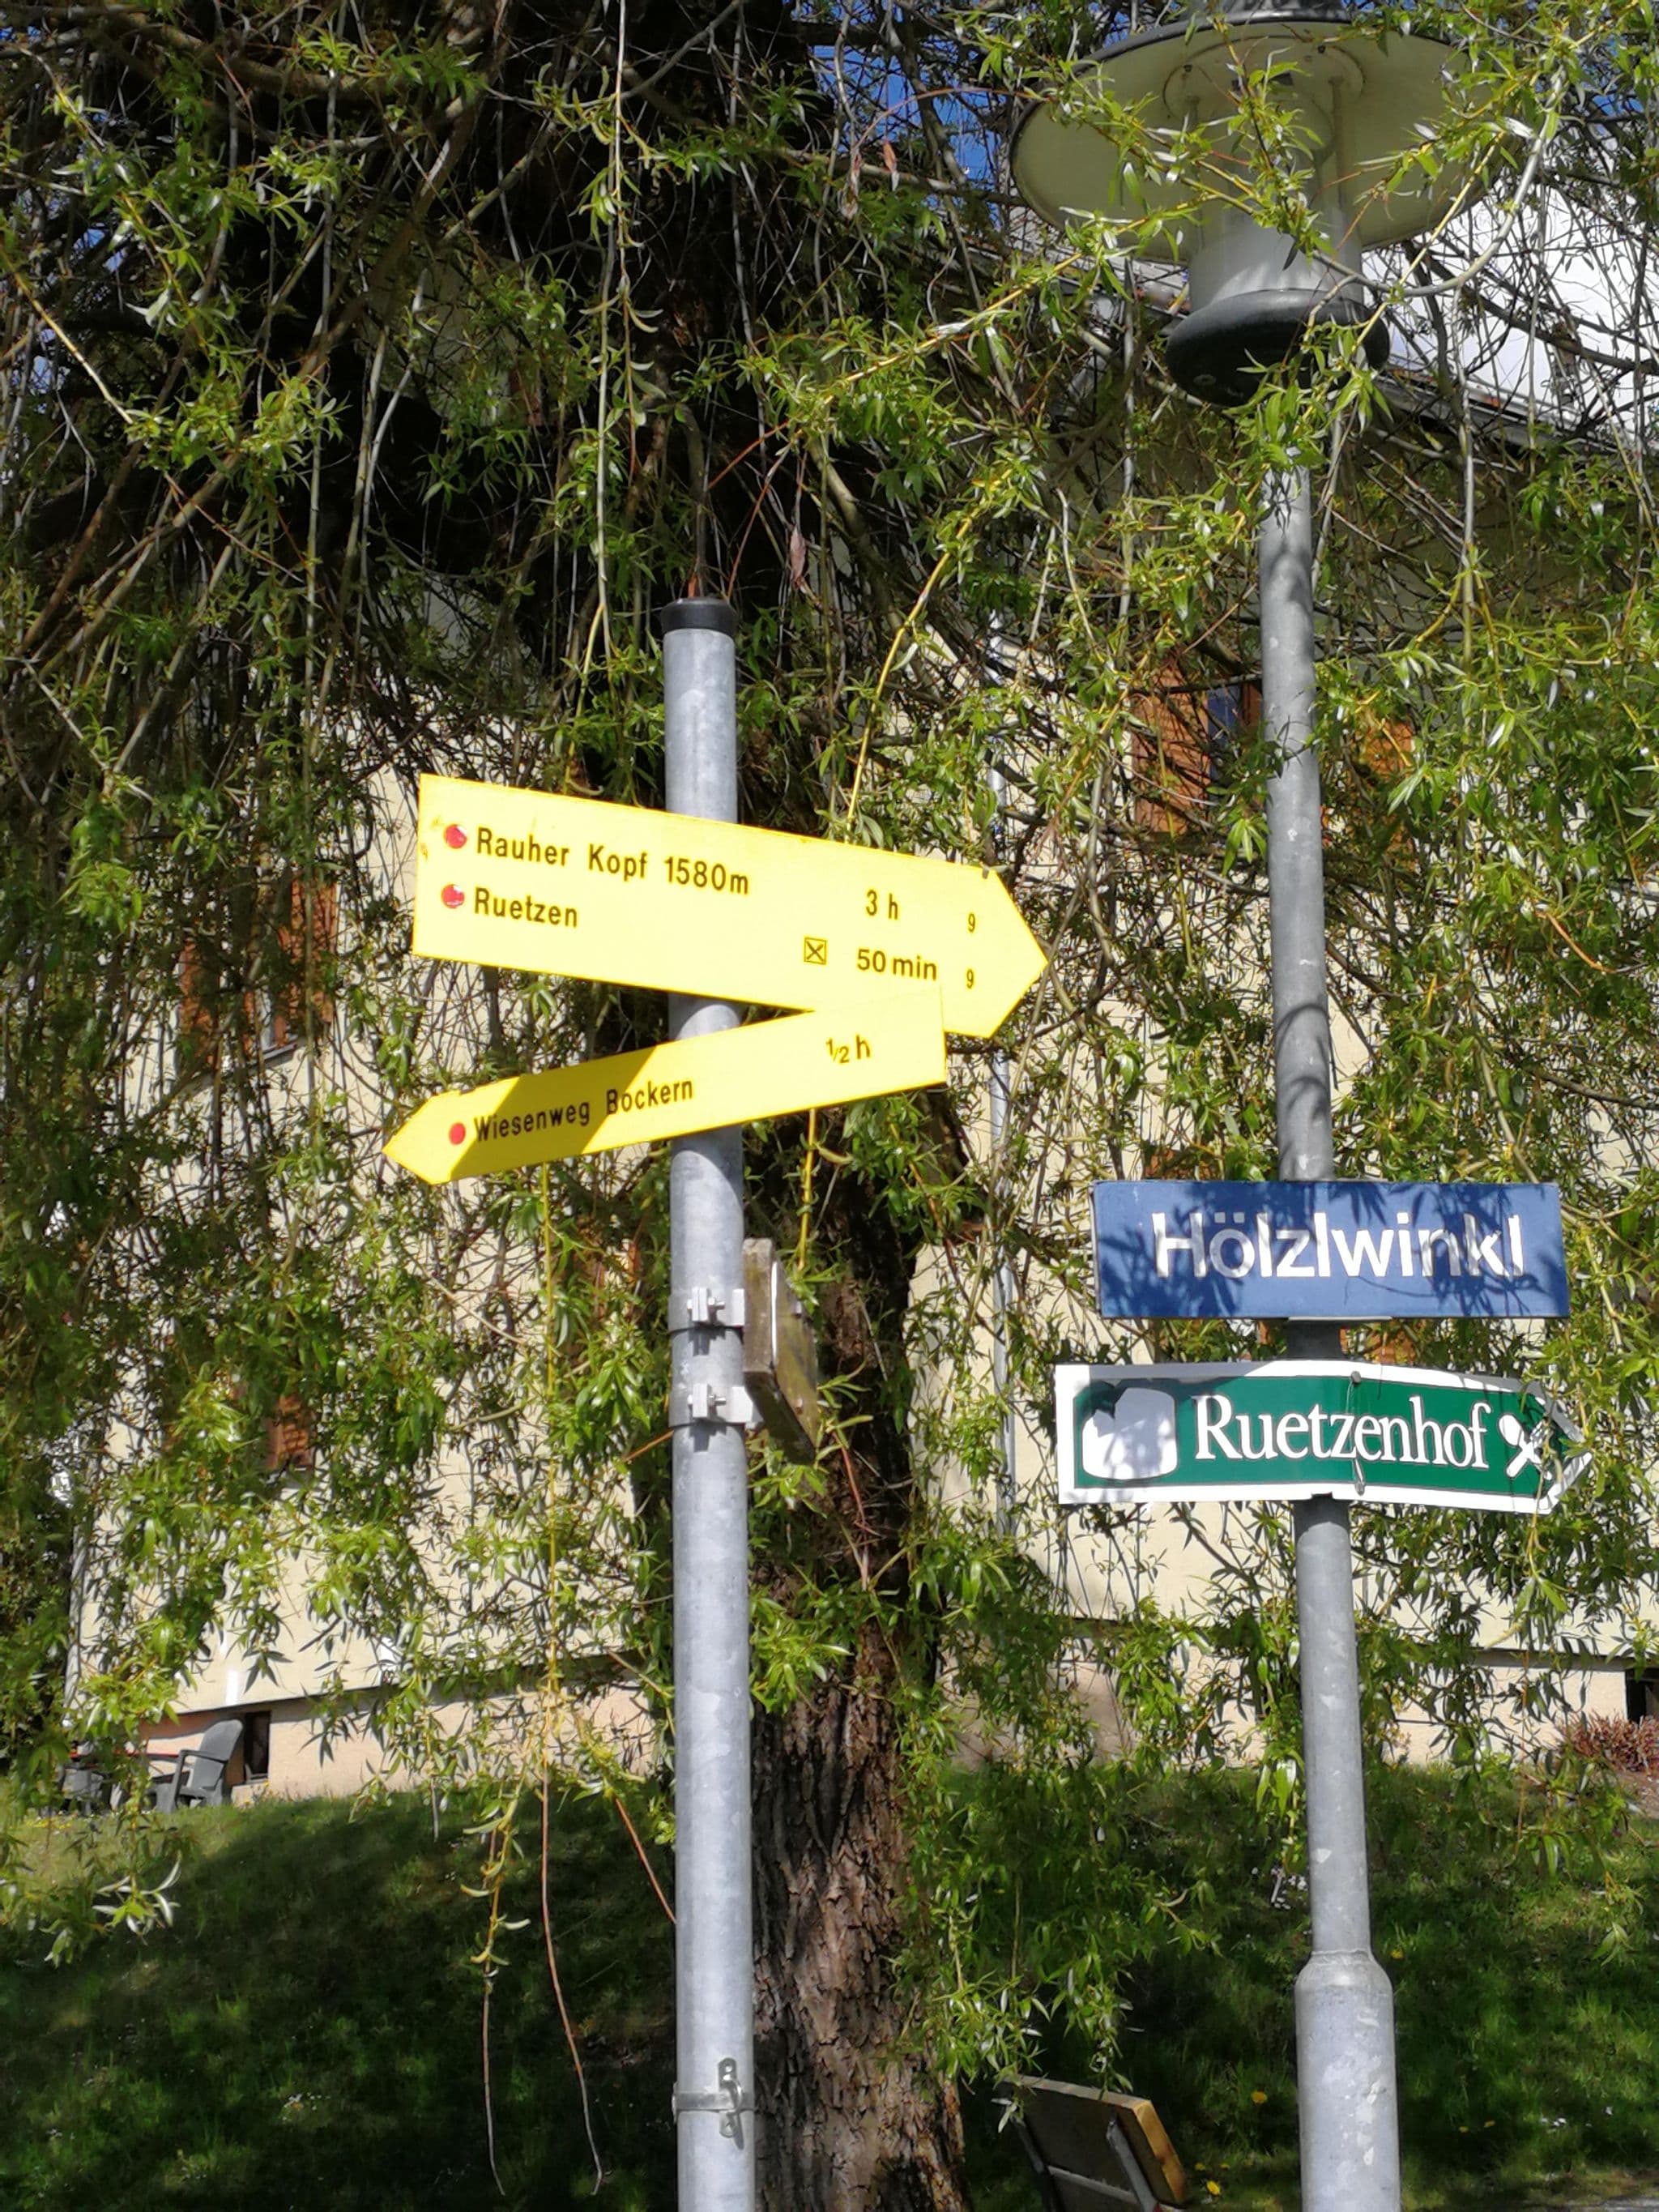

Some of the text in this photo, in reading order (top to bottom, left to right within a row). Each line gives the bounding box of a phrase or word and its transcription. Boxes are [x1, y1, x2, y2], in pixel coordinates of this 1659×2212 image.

[476, 826, 749, 895] Rauher Kopf 1580m
[474, 886, 578, 928] Ruetzen
[865, 889, 898, 920] 3 h
[967, 912, 976, 933] 9
[856, 948, 937, 981] 50 min
[966, 968, 975, 989] 9
[474, 1079, 694, 1142] Wiesenweg Bockern
[1151, 1211, 1525, 1279] Hölzlwinkl
[1191, 1393, 1492, 1470] Ruetzenhof
